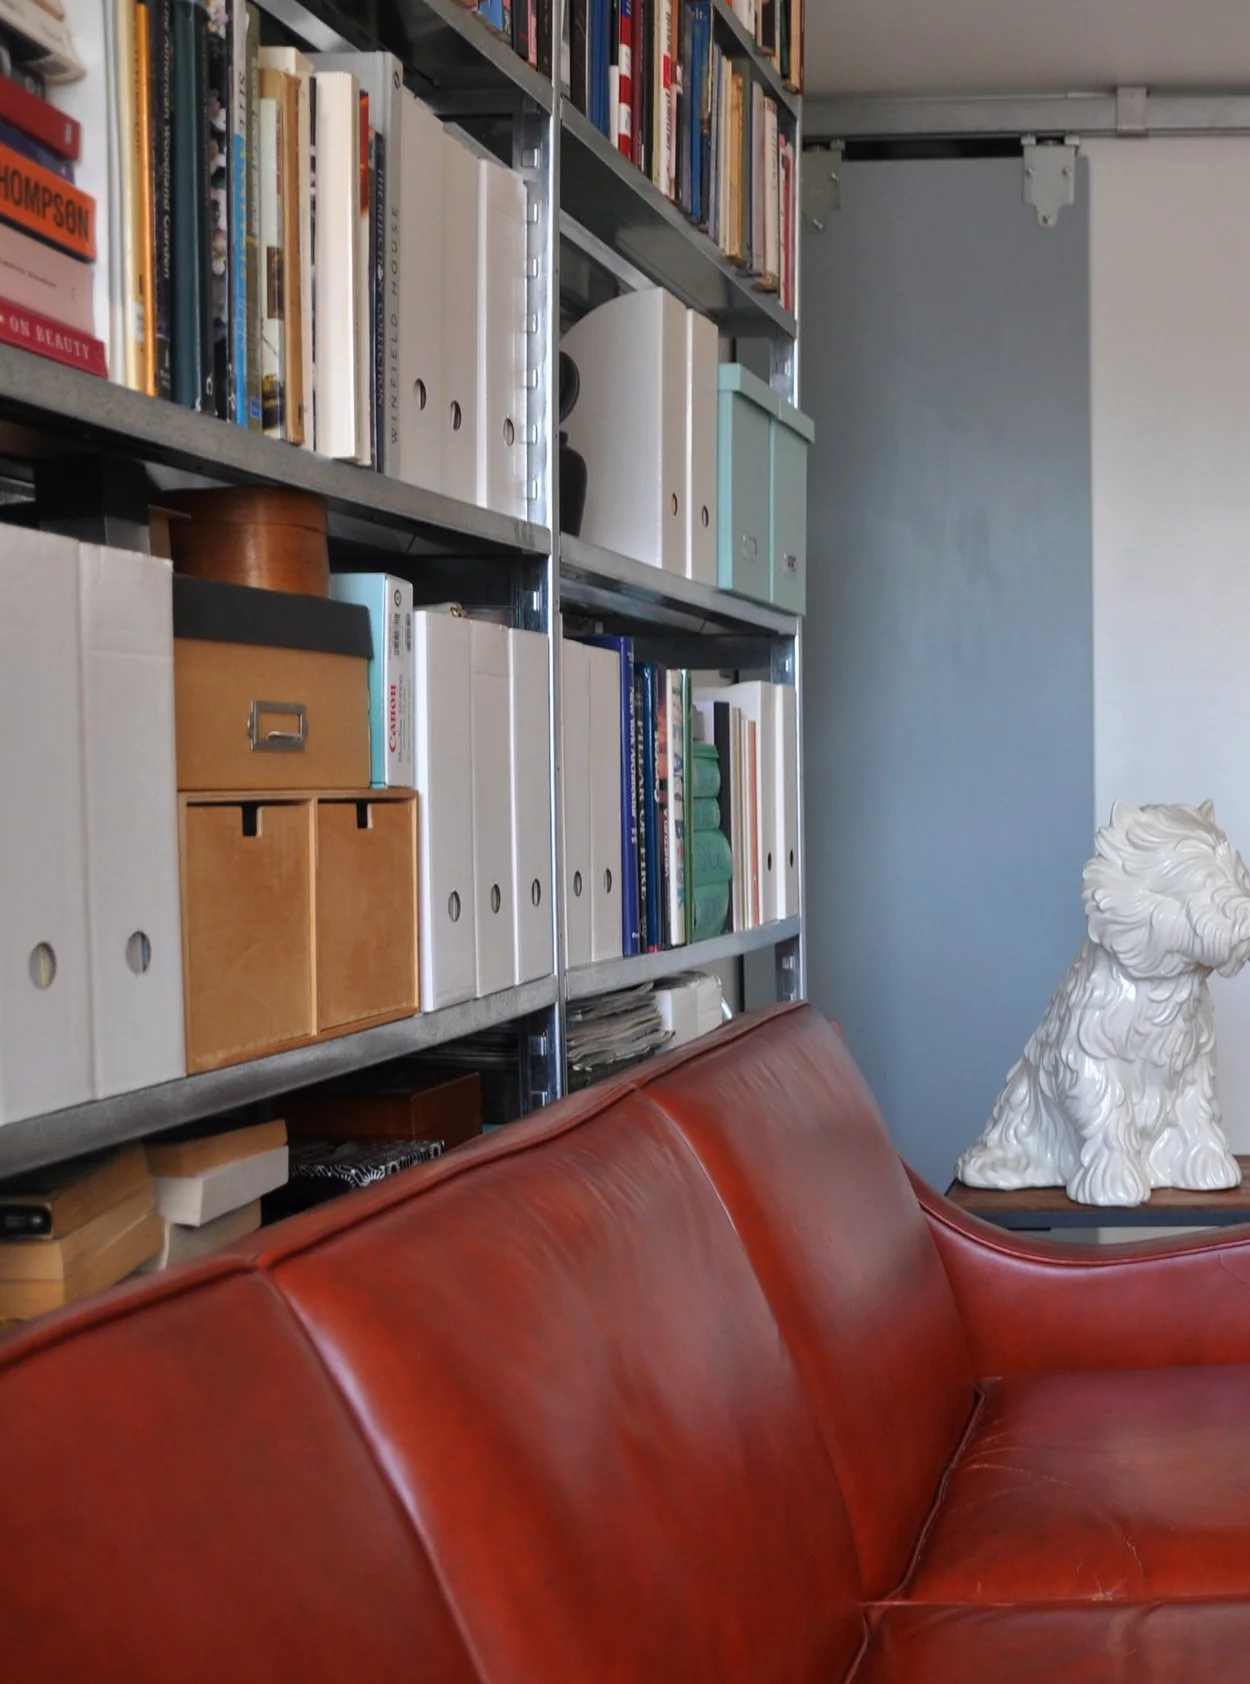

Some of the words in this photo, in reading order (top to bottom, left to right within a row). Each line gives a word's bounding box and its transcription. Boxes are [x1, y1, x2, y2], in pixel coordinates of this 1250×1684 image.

[390, 206, 398, 275] HOUSE
[9, 311, 31, 338] ON
[36, 320, 91, 361] BEAUTY
[390, 313, 398, 445] WINFIELD
[389, 684, 397, 753] Canon
[637, 719, 646, 802] PILLAR
